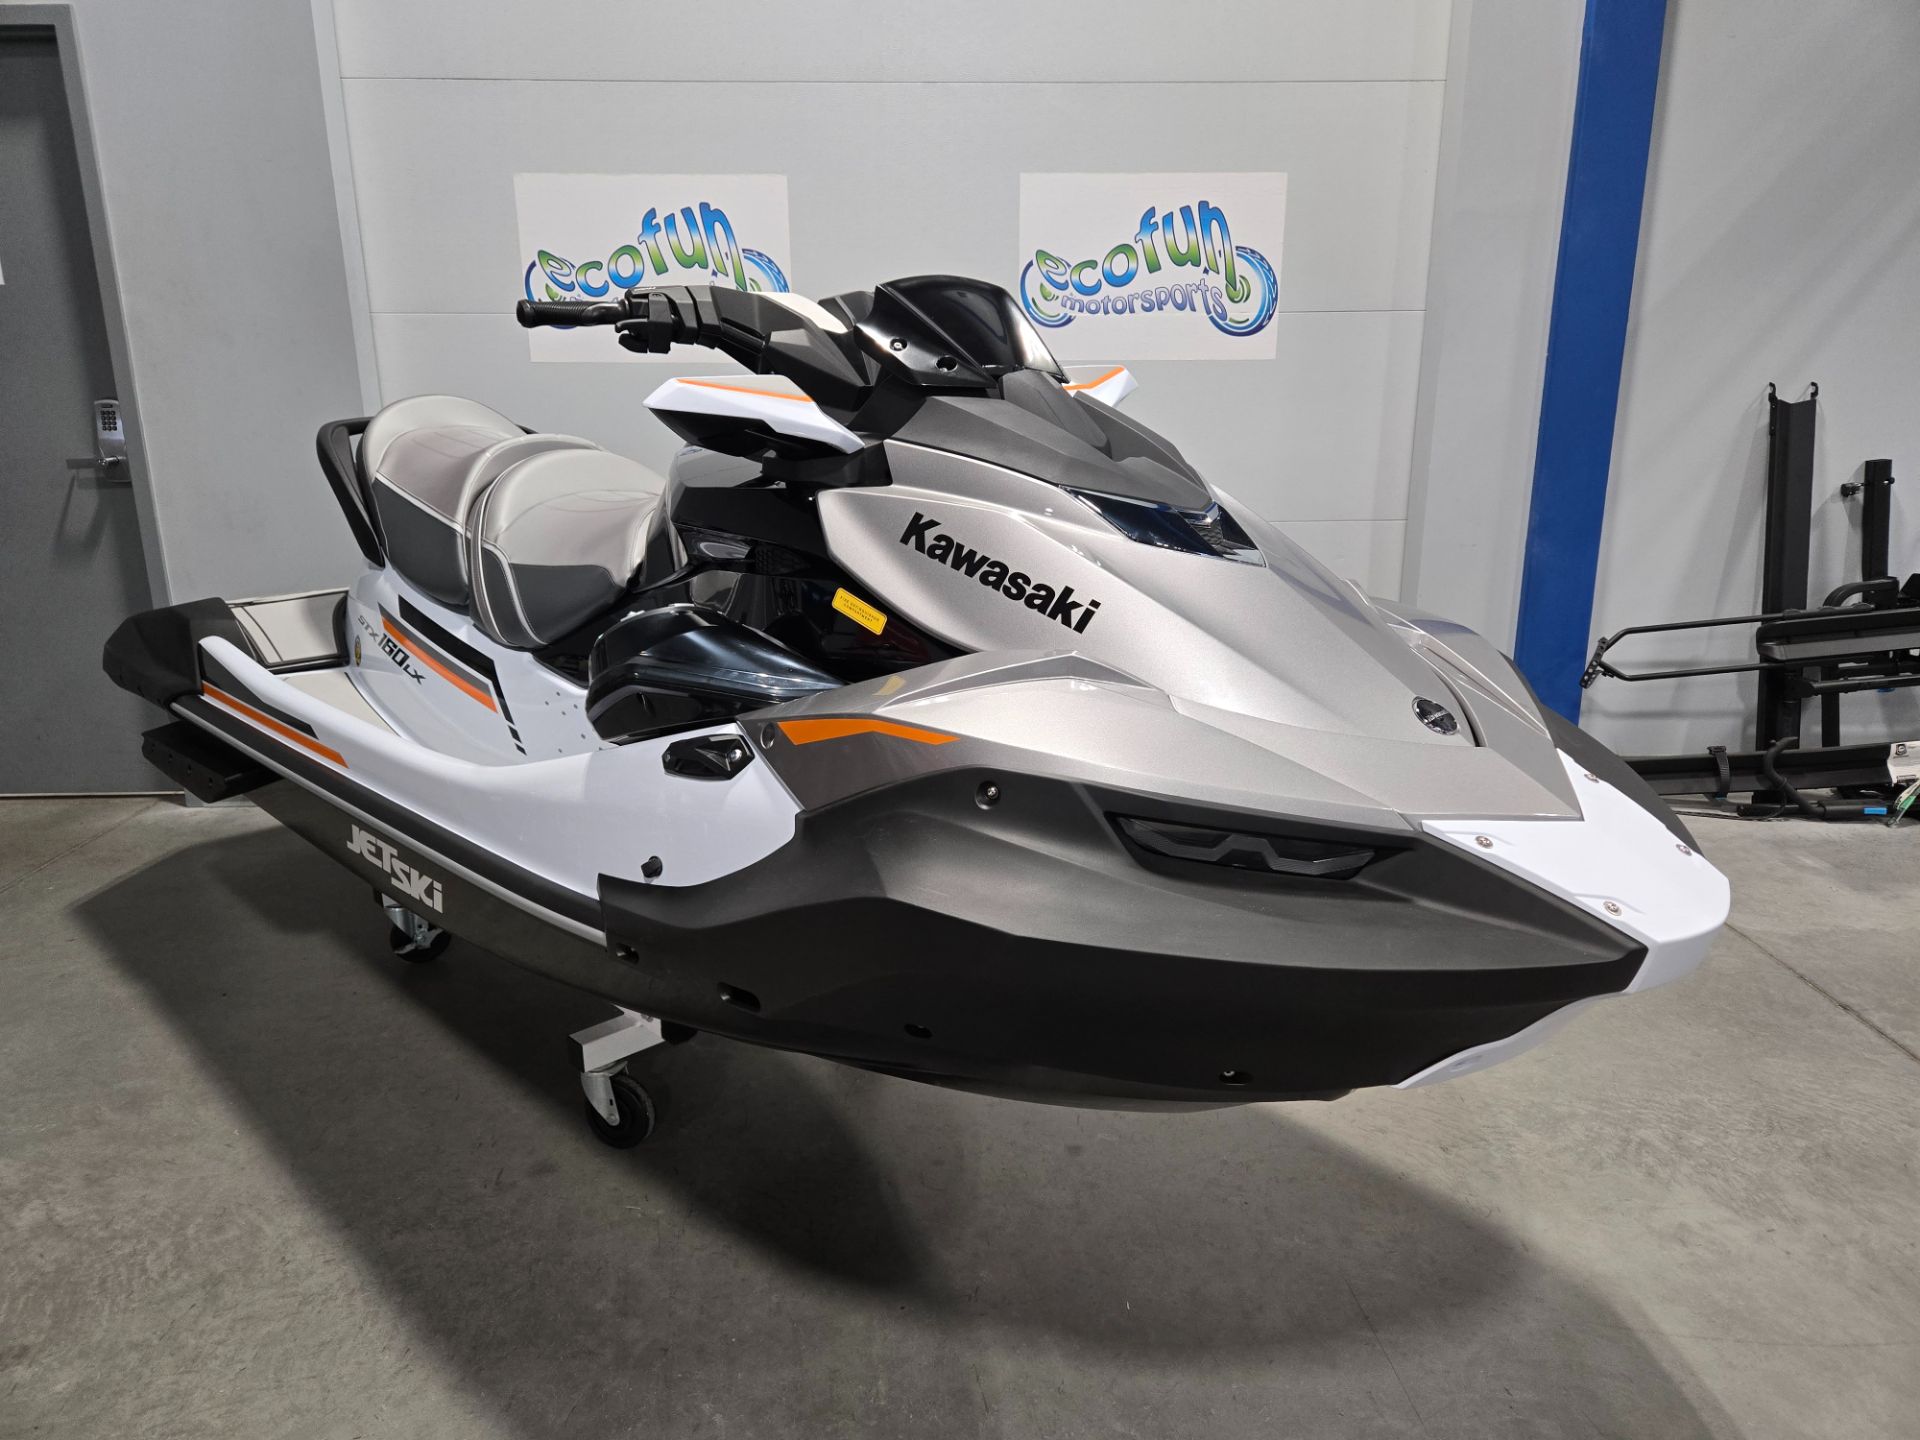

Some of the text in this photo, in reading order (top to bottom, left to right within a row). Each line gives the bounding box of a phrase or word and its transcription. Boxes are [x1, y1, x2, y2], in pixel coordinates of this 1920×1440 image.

[537, 202, 748, 298] ecofun
[1035, 200, 1237, 296] ecofun
[1060, 279, 1228, 322] motorsports
[899, 511, 1102, 635] Kawasaki
